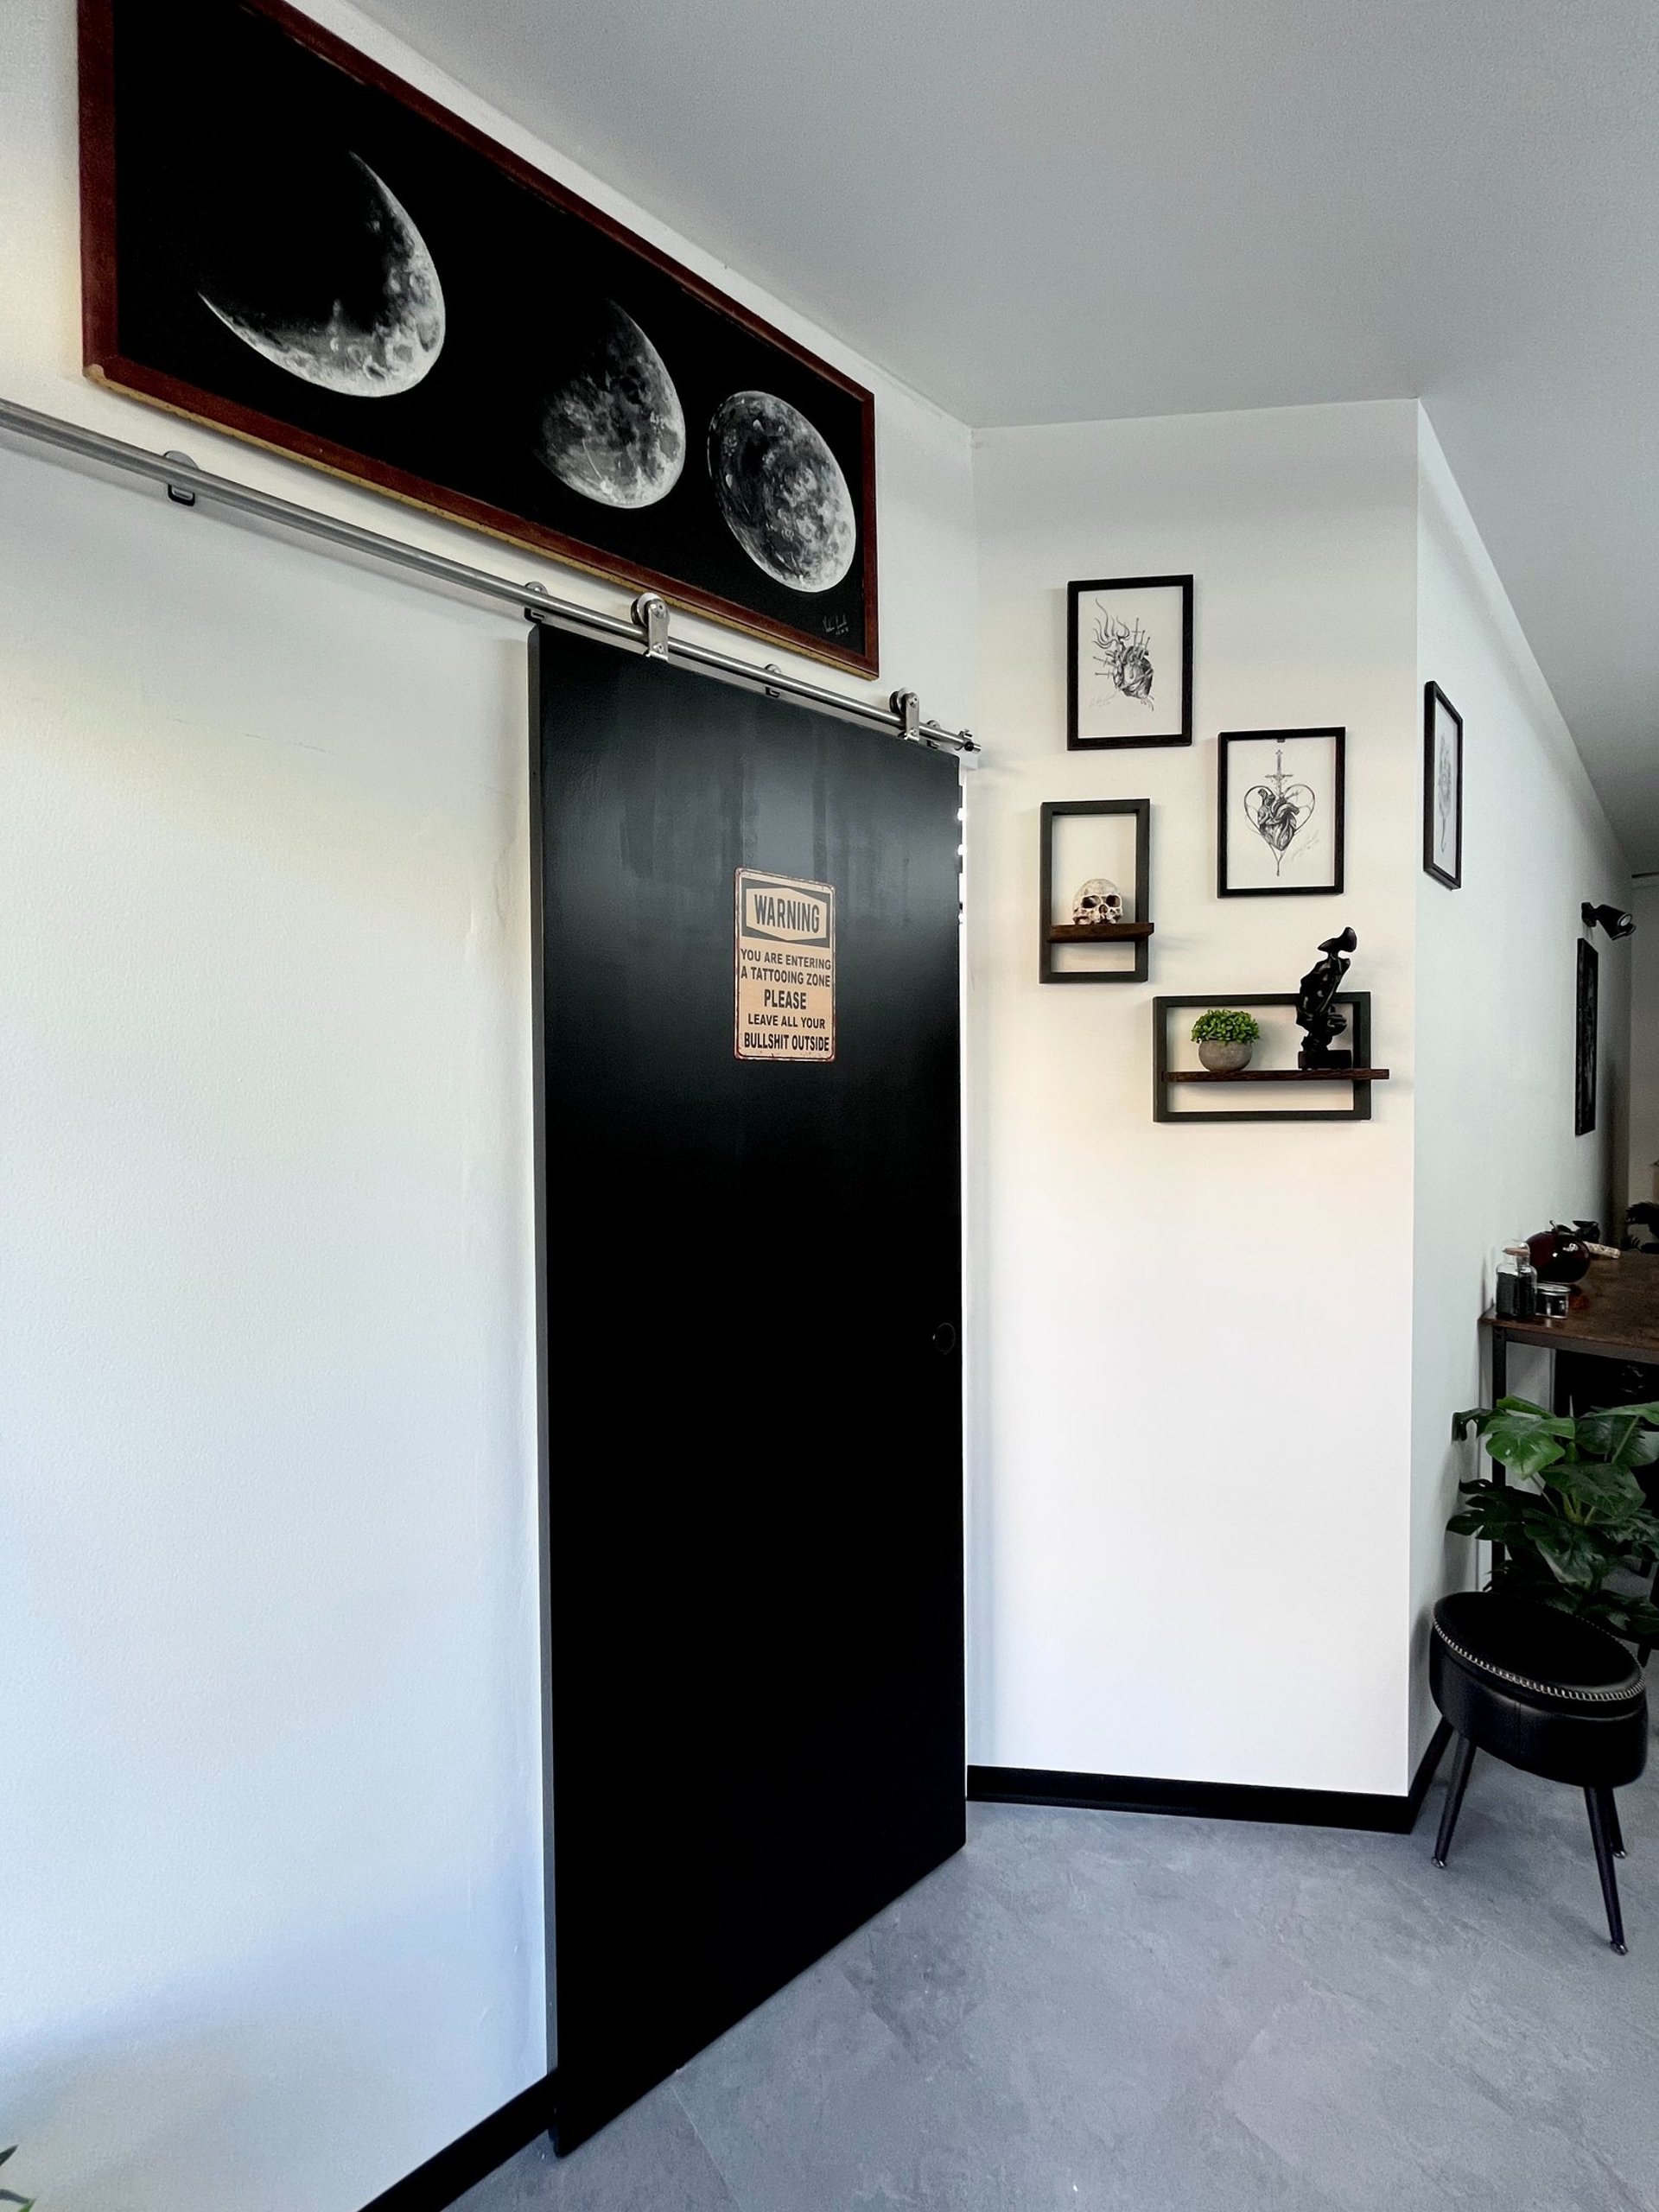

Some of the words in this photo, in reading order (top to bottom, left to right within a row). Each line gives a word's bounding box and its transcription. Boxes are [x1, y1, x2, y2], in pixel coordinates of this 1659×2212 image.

[754, 894, 819, 933] WARNING
[741, 949, 761, 962] YOU
[764, 951, 783, 964] ARE
[785, 954, 831, 969] ENTERING
[741, 965, 747, 978] A
[751, 967, 804, 984] TATTOOING
[806, 973, 830, 987] ZONE
[764, 989, 807, 1009] PLEASE
[748, 1014, 778, 1026] LEAVE
[781, 1015, 798, 1027] ALL
[801, 1017, 825, 1029] YOUR
[744, 1033, 789, 1049] BULLSHIT
[792, 1035, 829, 1051] OUTSIDE
